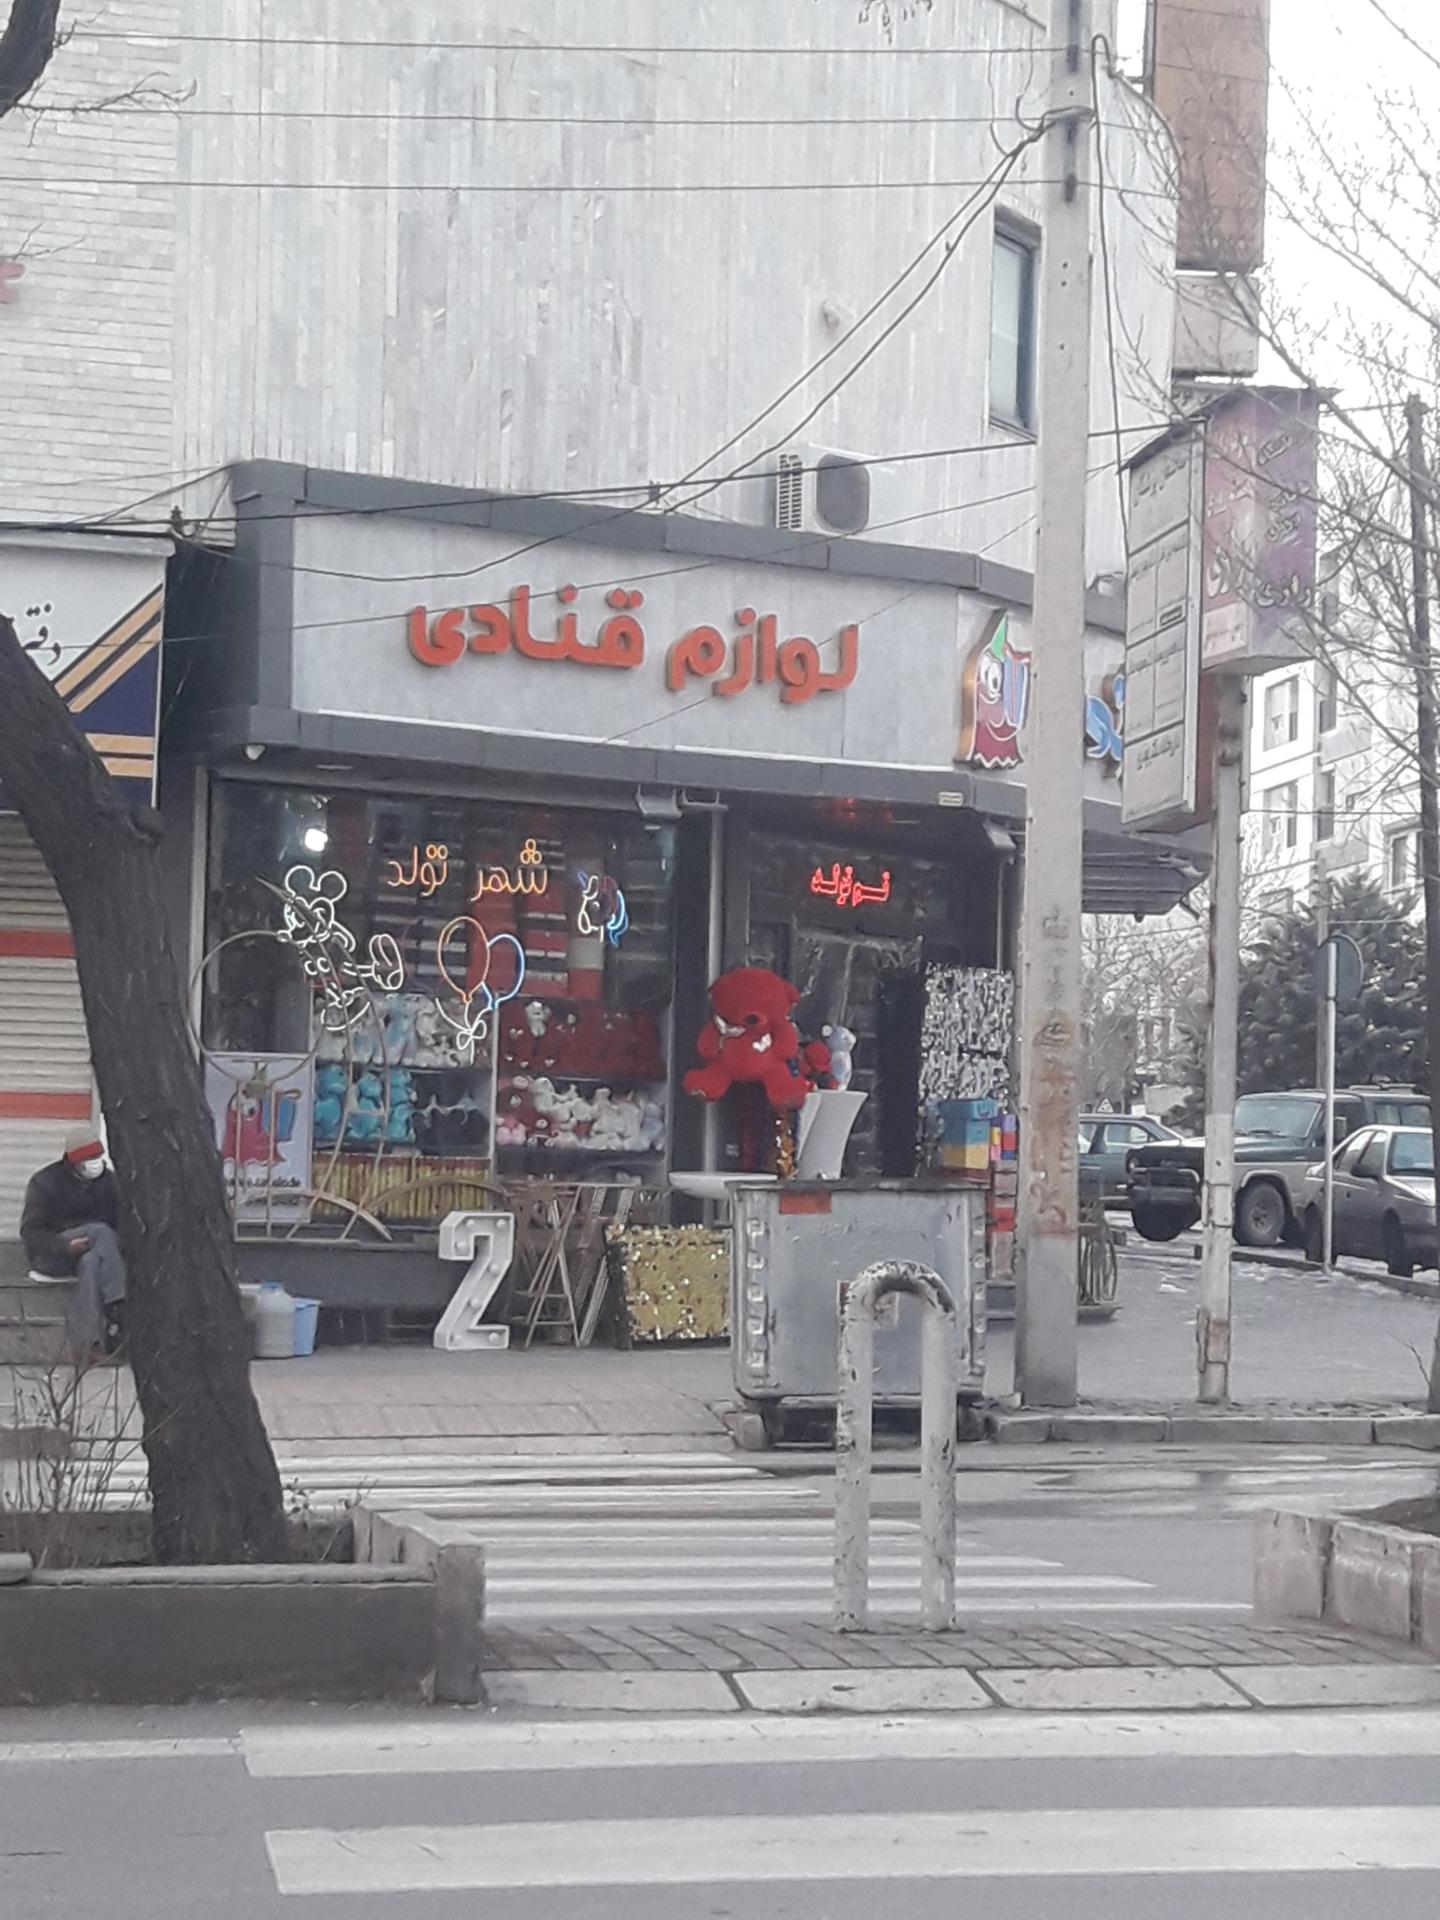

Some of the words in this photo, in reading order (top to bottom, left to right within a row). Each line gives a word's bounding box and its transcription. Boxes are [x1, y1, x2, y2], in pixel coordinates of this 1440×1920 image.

[409, 584, 644, 669] قنادی
[667, 607, 859, 704] لوازم
[387, 844, 449, 897] تولد
[470, 838, 547, 901] شهر
[433, 1211, 514, 1349] 2
